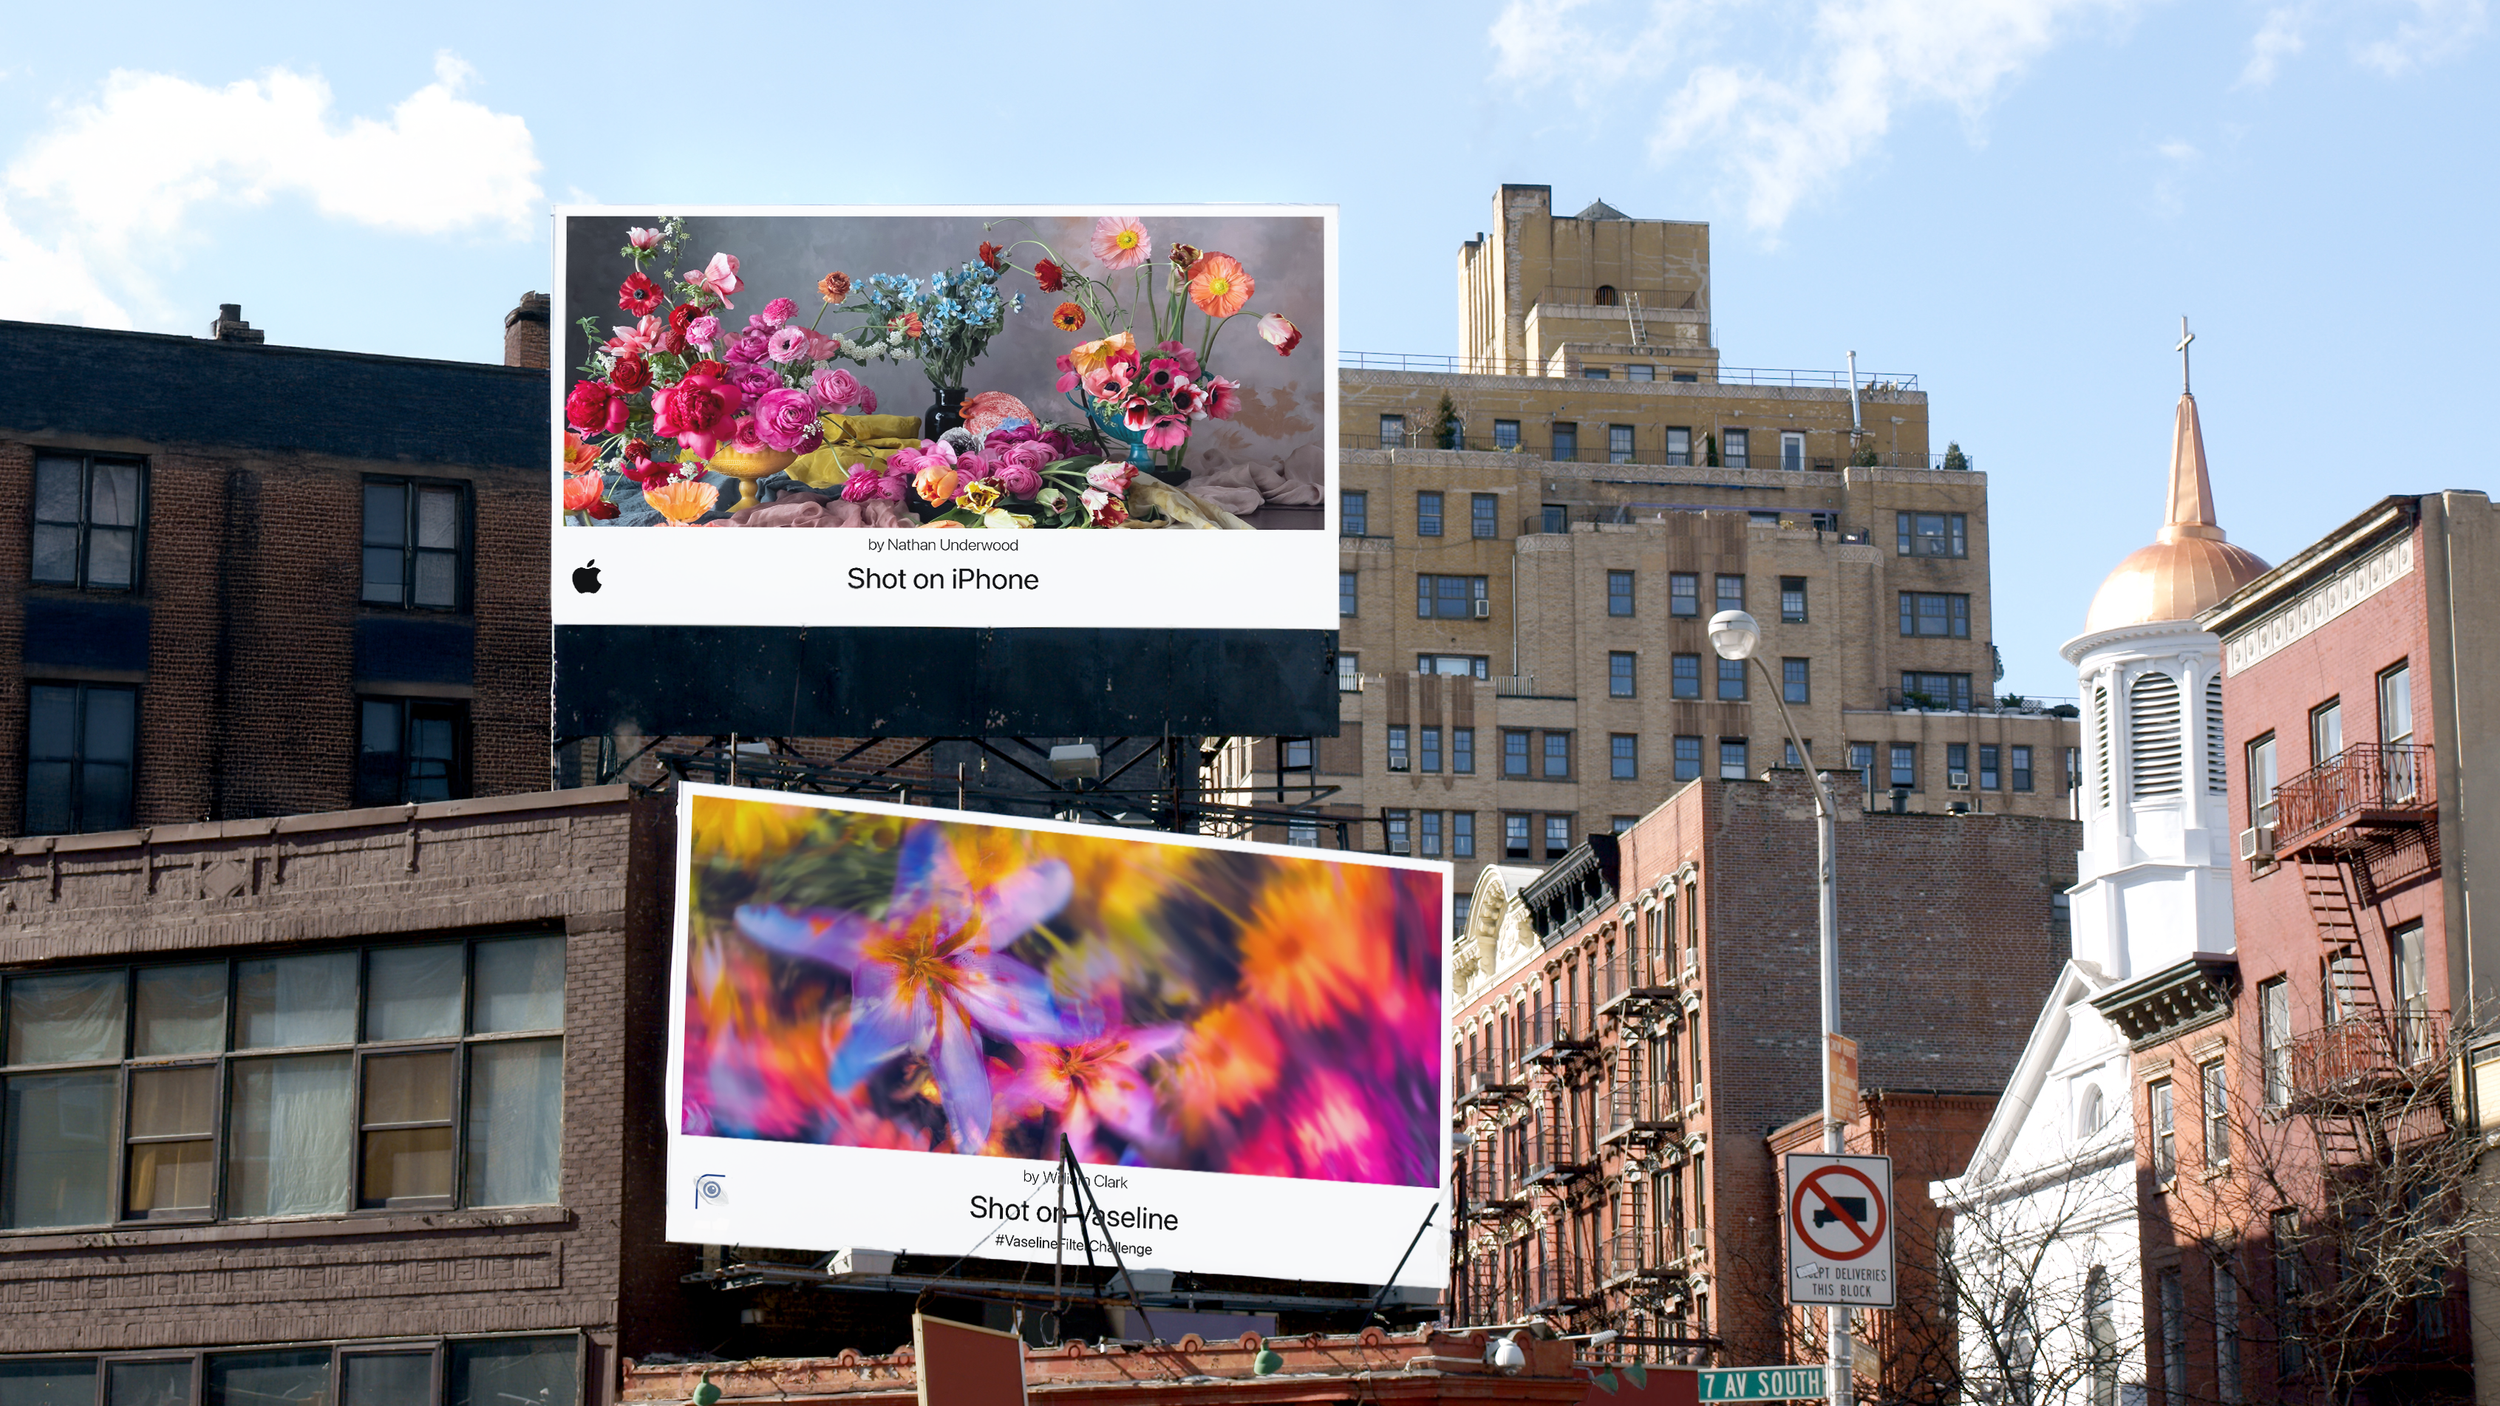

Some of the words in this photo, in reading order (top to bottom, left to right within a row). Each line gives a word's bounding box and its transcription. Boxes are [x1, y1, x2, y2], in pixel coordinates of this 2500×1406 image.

[868, 538, 884, 552] by
[887, 538, 936, 551] Nathan
[940, 538, 1019, 551] Underwood
[848, 567, 906, 589] Shot
[913, 573, 944, 589] on
[952, 568, 1039, 590] iPhone
[1023, 1169, 1040, 1185] by
[1043, 1171, 1091, 1187] Wilim
[1093, 1174, 1128, 1189] Clark
[970, 1195, 1030, 1222] Shot
[1036, 1205, 1068, 1224] on
[995, 1233, 1153, 1258] #VaselineilteChallenge
[1835, 1267, 1887, 1282] DELIVERIES
[1812, 1283, 1834, 1296] THIS
[1840, 1284, 1872, 1298] BLOCK
[1704, 1374, 1716, 1399] 7
[1724, 1373, 1747, 1398] AV
[1758, 1370, 1820, 1397] SOUTH
